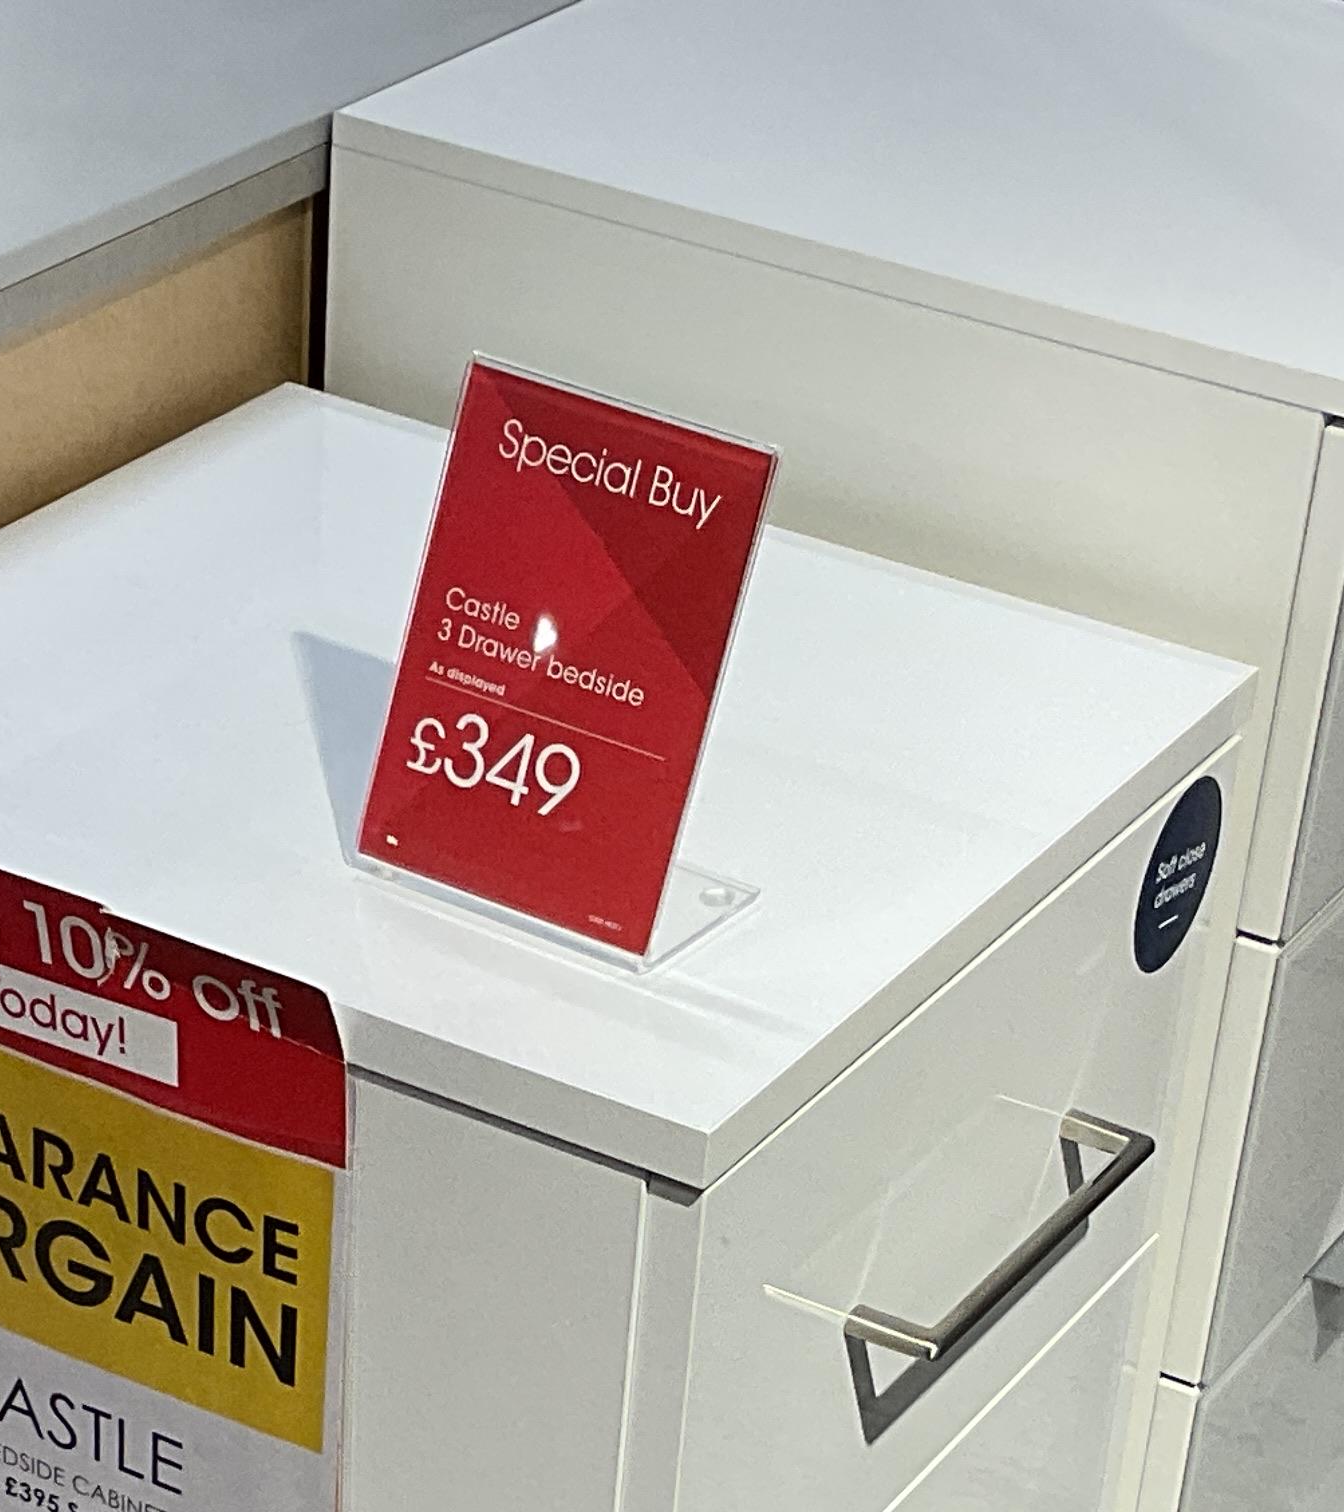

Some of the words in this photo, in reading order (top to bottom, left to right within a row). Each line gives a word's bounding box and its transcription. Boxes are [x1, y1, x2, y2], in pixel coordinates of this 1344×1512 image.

[498, 418, 639, 499] Special
[649, 466, 722, 530] Buy
[445, 587, 520, 631] Castle
[429, 661, 444, 676] As
[446, 668, 505, 696] displayed
[437, 618, 452, 642] 3
[458, 624, 541, 671] Drawer
[547, 654, 645, 706] bedside
[406, 713, 581, 816] £349
[23, 900, 171, 1001] 10%
